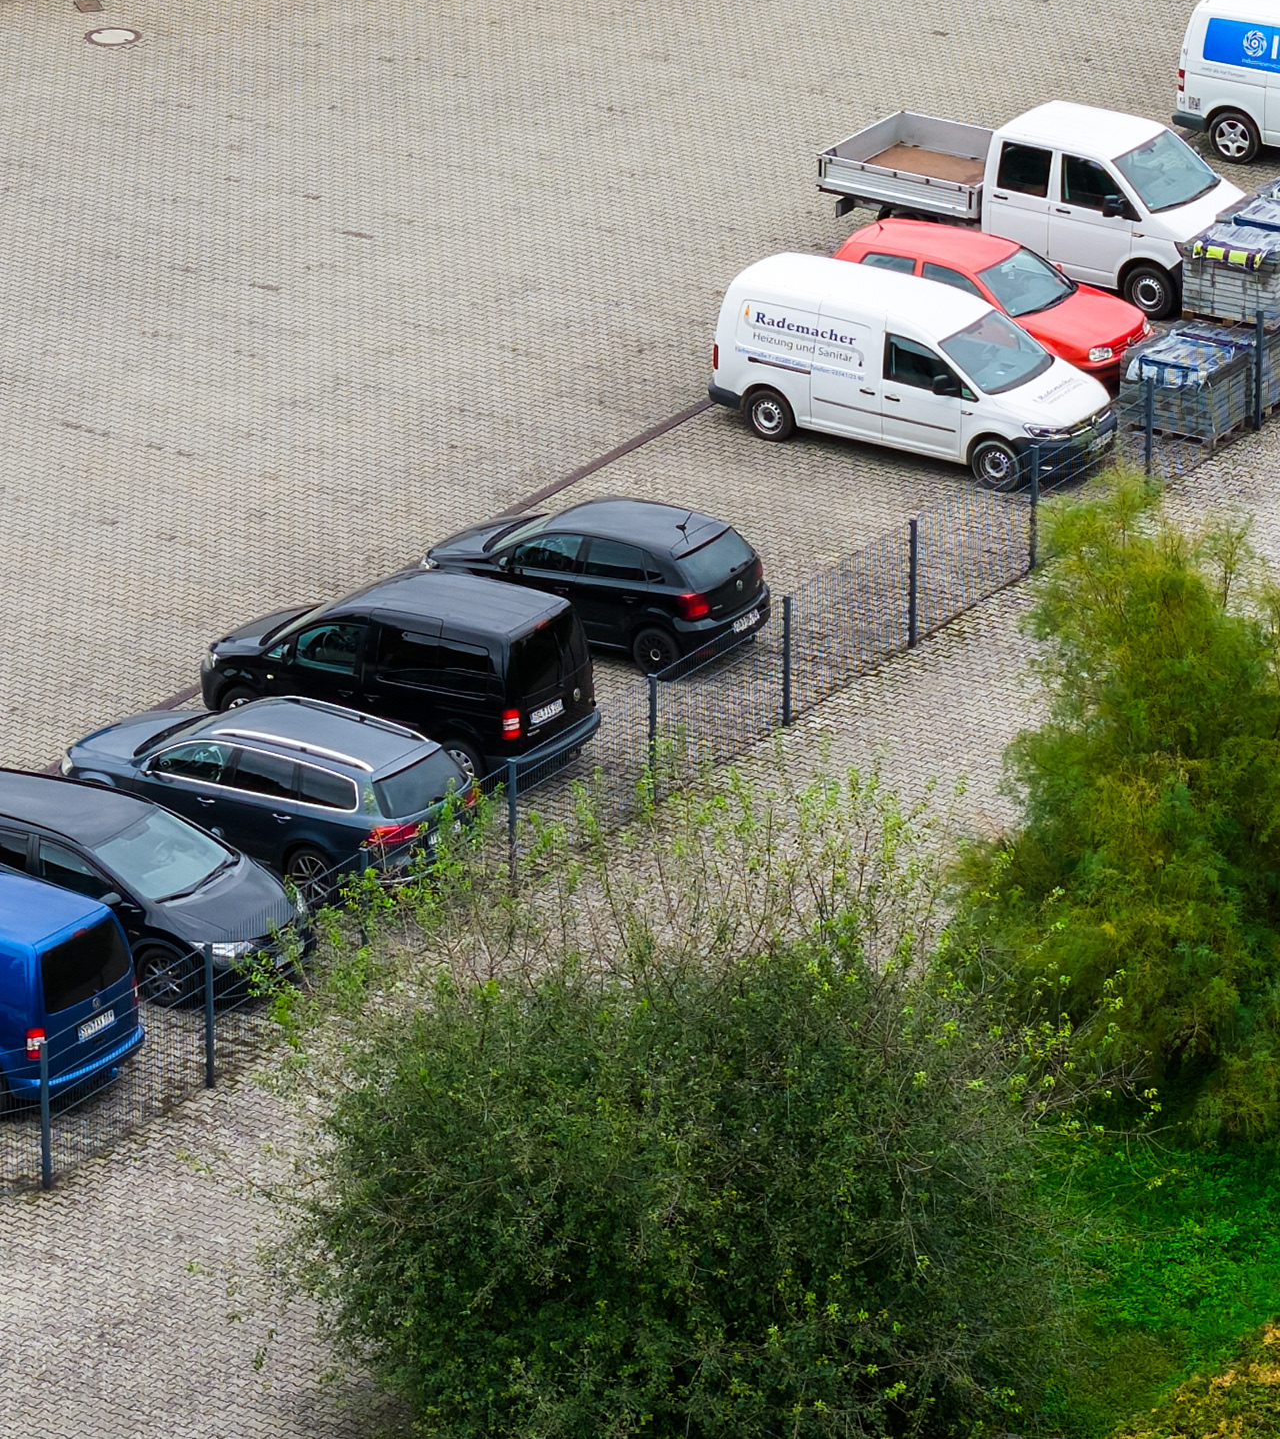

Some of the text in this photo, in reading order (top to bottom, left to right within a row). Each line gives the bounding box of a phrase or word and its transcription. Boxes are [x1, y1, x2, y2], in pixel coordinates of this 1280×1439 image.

[755, 311, 857, 345] Rademacher
[753, 331, 853, 362] Heizung und Sanitär
